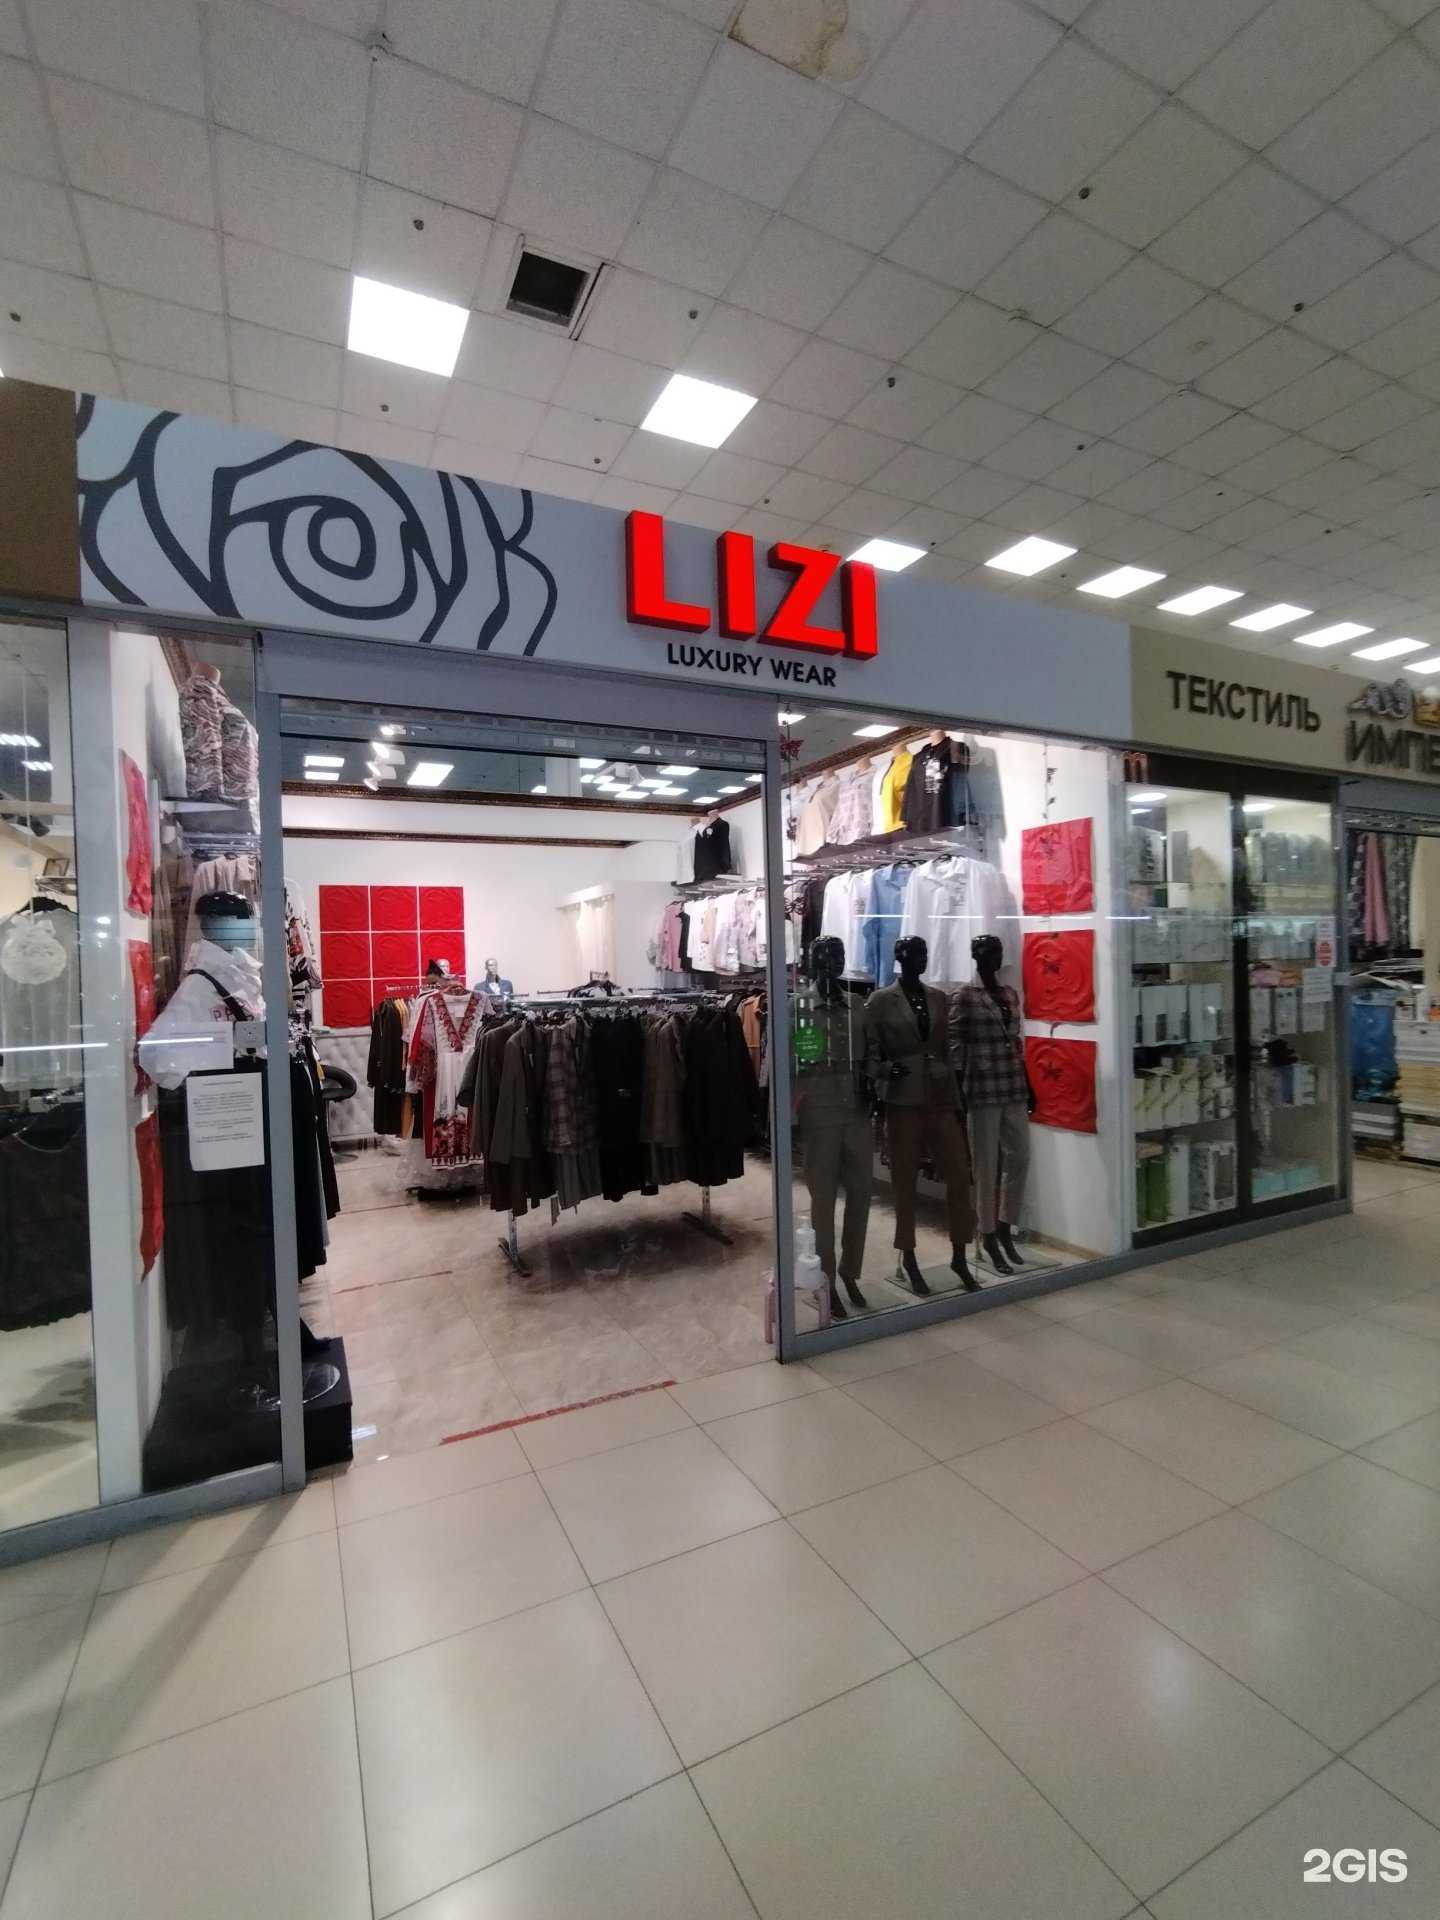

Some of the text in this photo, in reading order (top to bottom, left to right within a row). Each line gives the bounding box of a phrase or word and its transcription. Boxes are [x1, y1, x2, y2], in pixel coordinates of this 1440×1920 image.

[624, 510, 878, 660] LIZI
[667, 643, 837, 687] LUXURY WEAR
[1166, 670, 1321, 733] ТЕКСТИЛЬ
